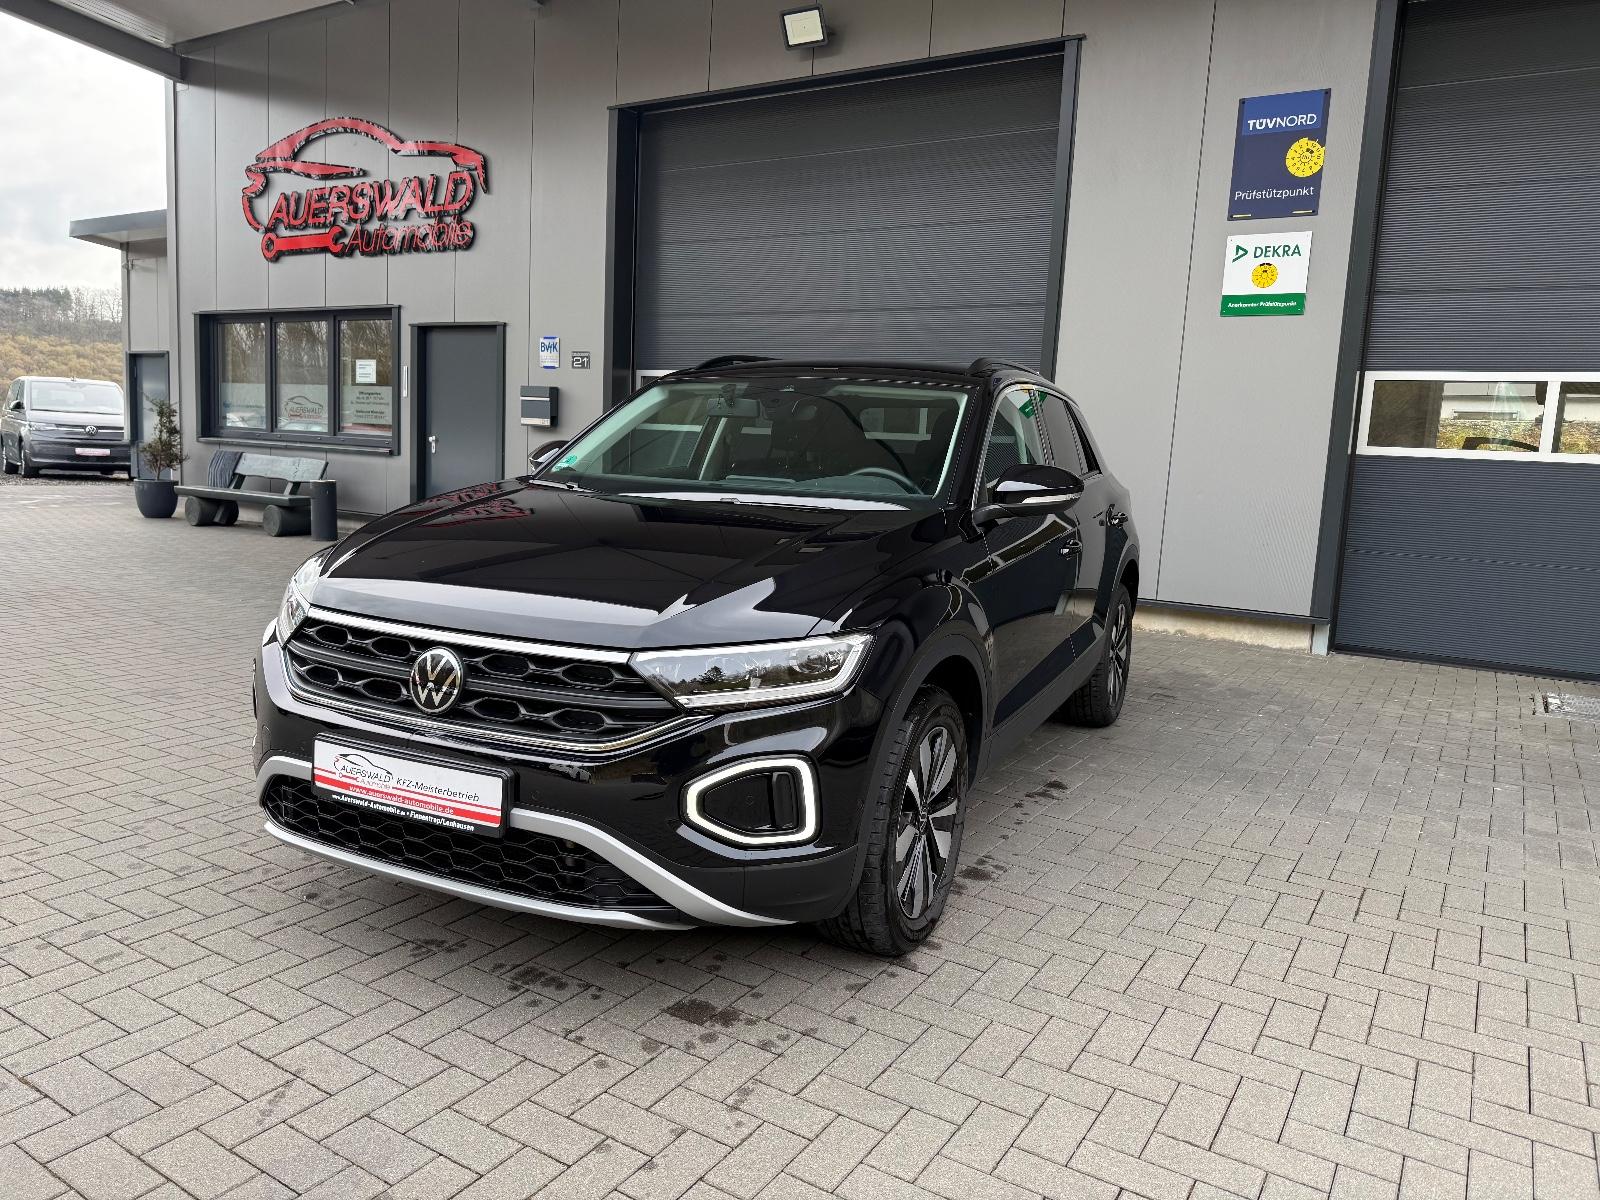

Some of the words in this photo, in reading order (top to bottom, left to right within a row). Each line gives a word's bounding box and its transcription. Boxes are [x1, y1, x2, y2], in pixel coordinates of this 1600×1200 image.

[267, 171, 473, 230] AUERSWALD
[1234, 186, 1315, 201] Prüfstützpunkt
[346, 217, 473, 254] Automobile
[1253, 244, 1302, 259] DEKRA
[1259, 300, 1298, 308] Prüfstützpunkt
[573, 356, 588, 368] 21
[340, 764, 392, 783] AUERSWALD
[396, 777, 480, 802] KFZ-Meisterbetrieb
[348, 785, 455, 815] www.auerswald-automobile.de
